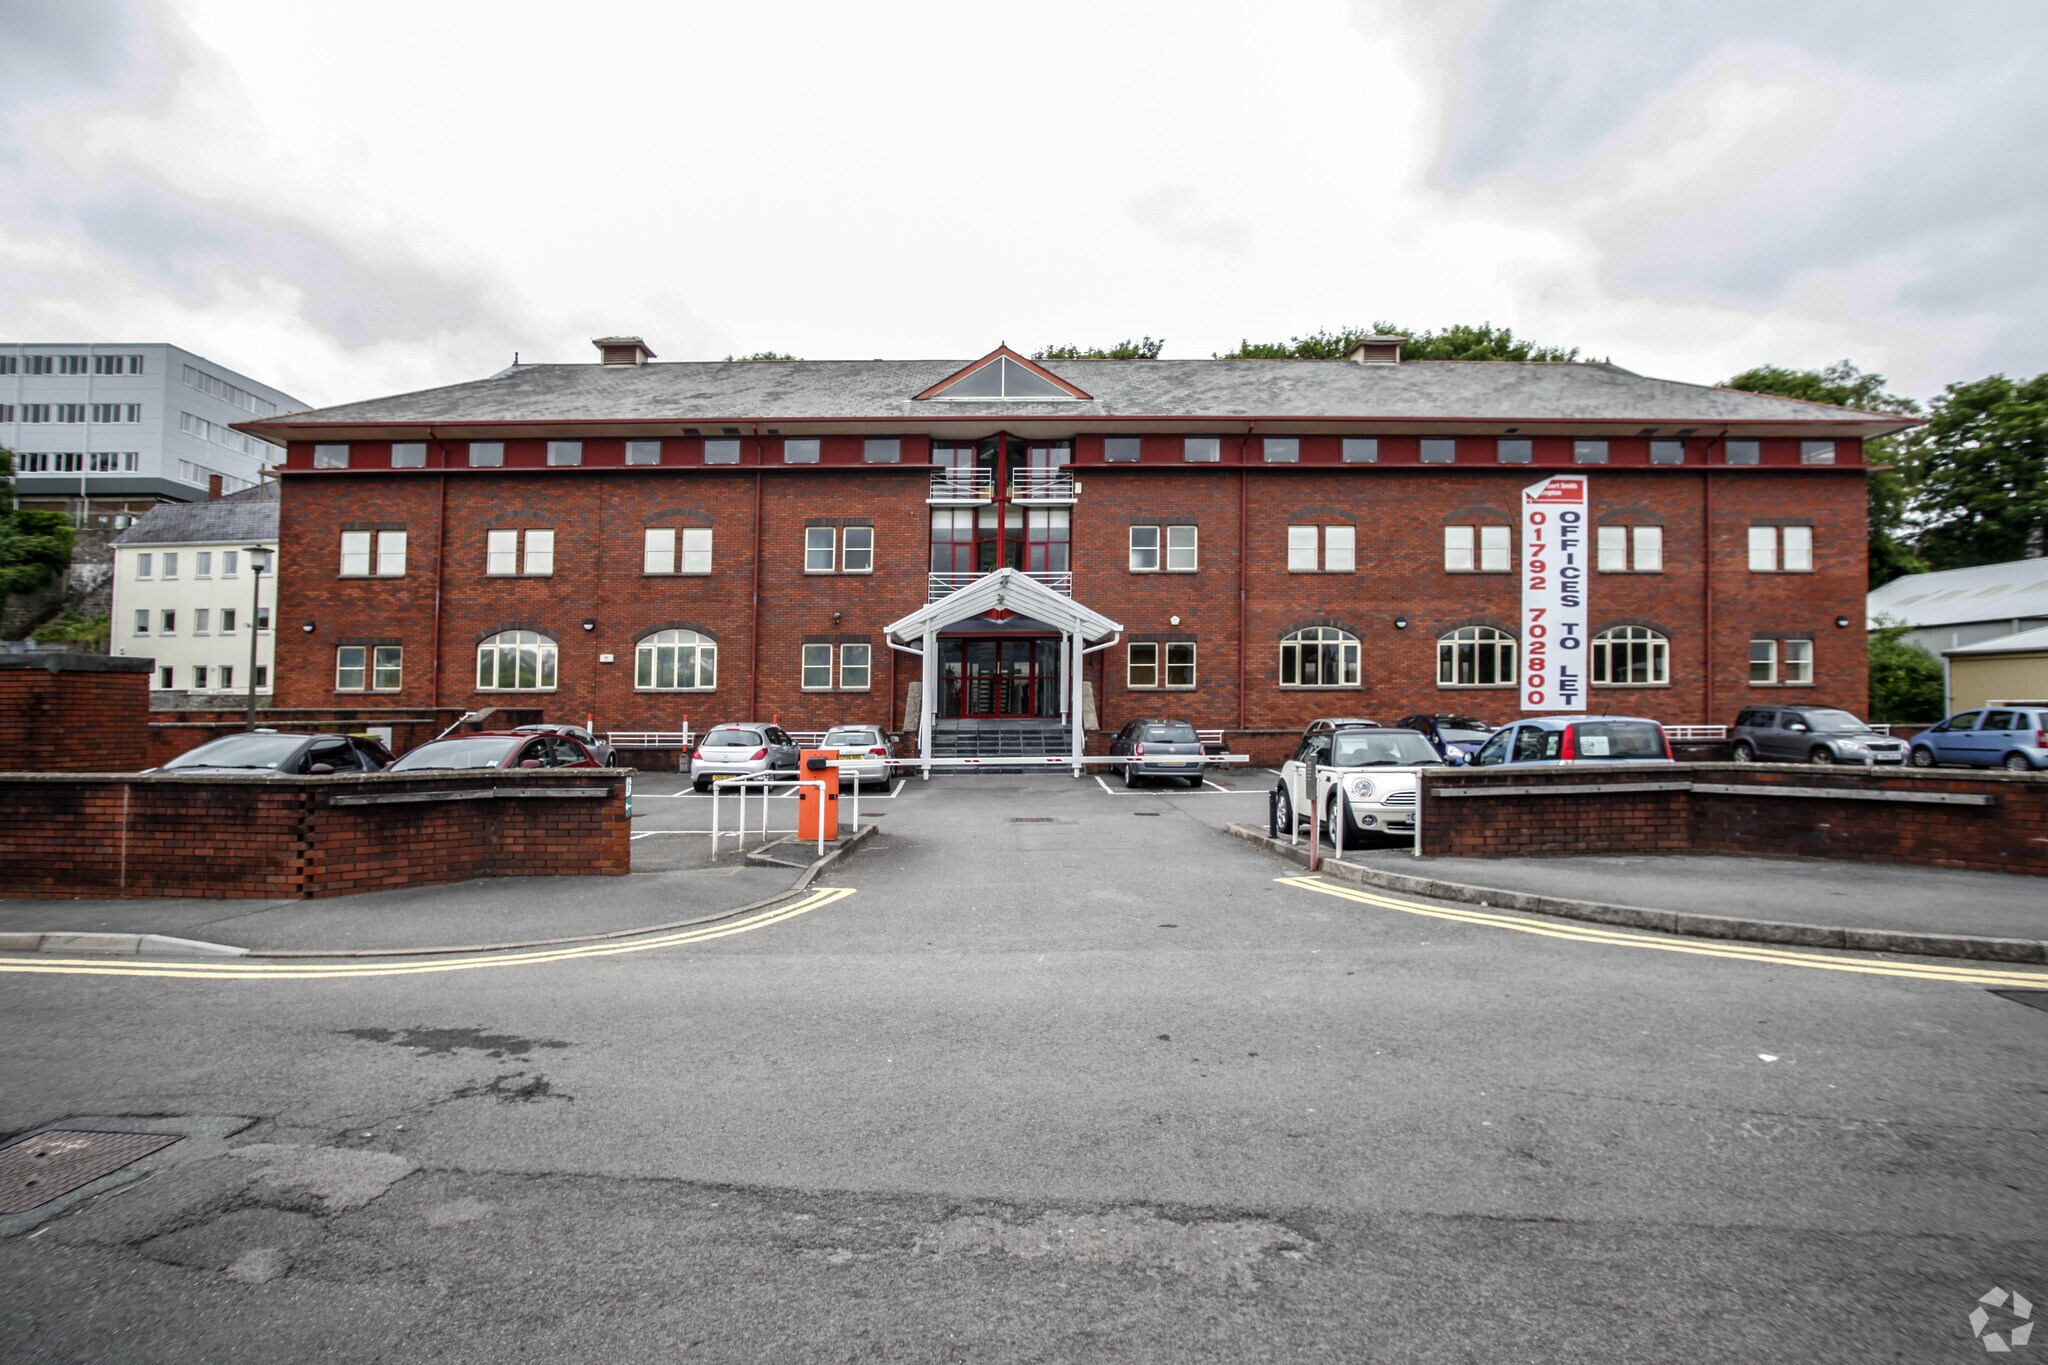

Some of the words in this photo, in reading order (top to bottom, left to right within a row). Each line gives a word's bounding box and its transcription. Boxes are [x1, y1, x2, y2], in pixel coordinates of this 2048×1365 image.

[1529, 511, 1546, 589] 01792
[1559, 511, 1581, 607] OFFICES
[1528, 608, 1547, 705] 702800
[1560, 623, 1580, 649] TO
[1559, 666, 1578, 705] LET
